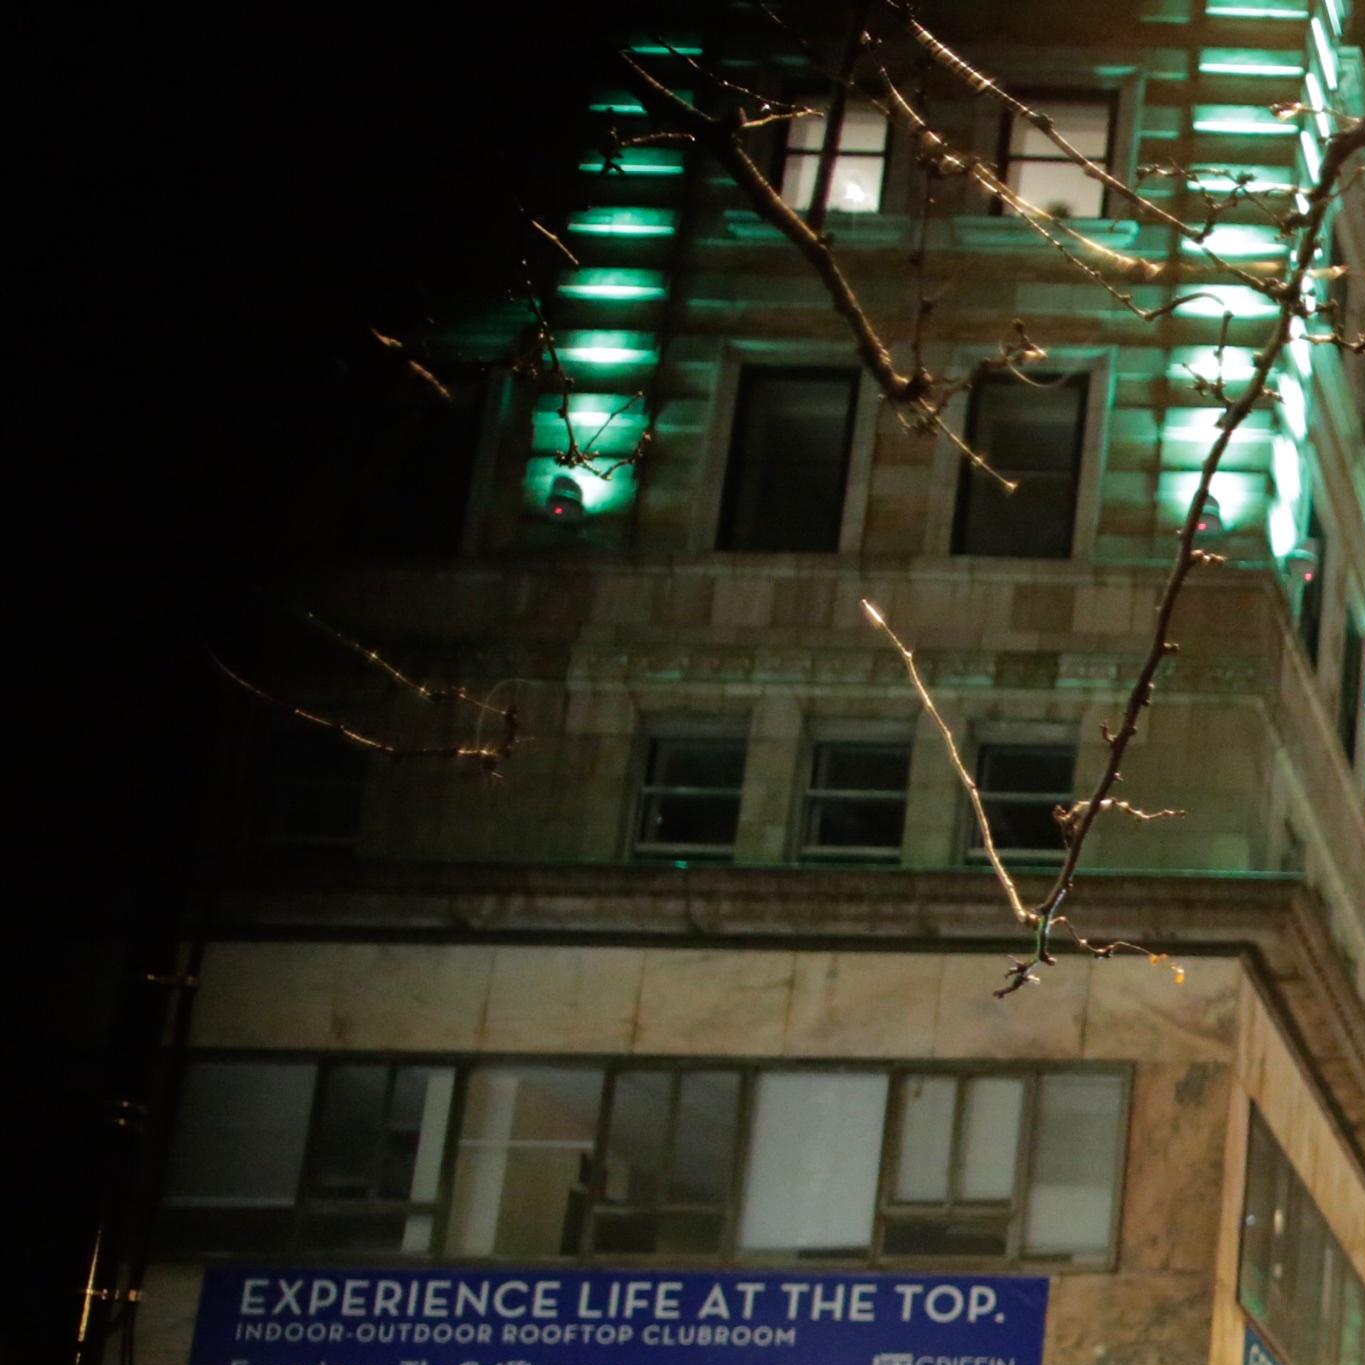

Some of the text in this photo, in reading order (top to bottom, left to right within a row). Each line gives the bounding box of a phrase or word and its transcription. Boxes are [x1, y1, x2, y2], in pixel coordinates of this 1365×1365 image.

[240, 1278, 1005, 1324] EXPERIENCE LIFE AT THE TOP.
[234, 1322, 797, 1347] INDOOR-OUTDOOR ROOFTOP CLUBROOM
